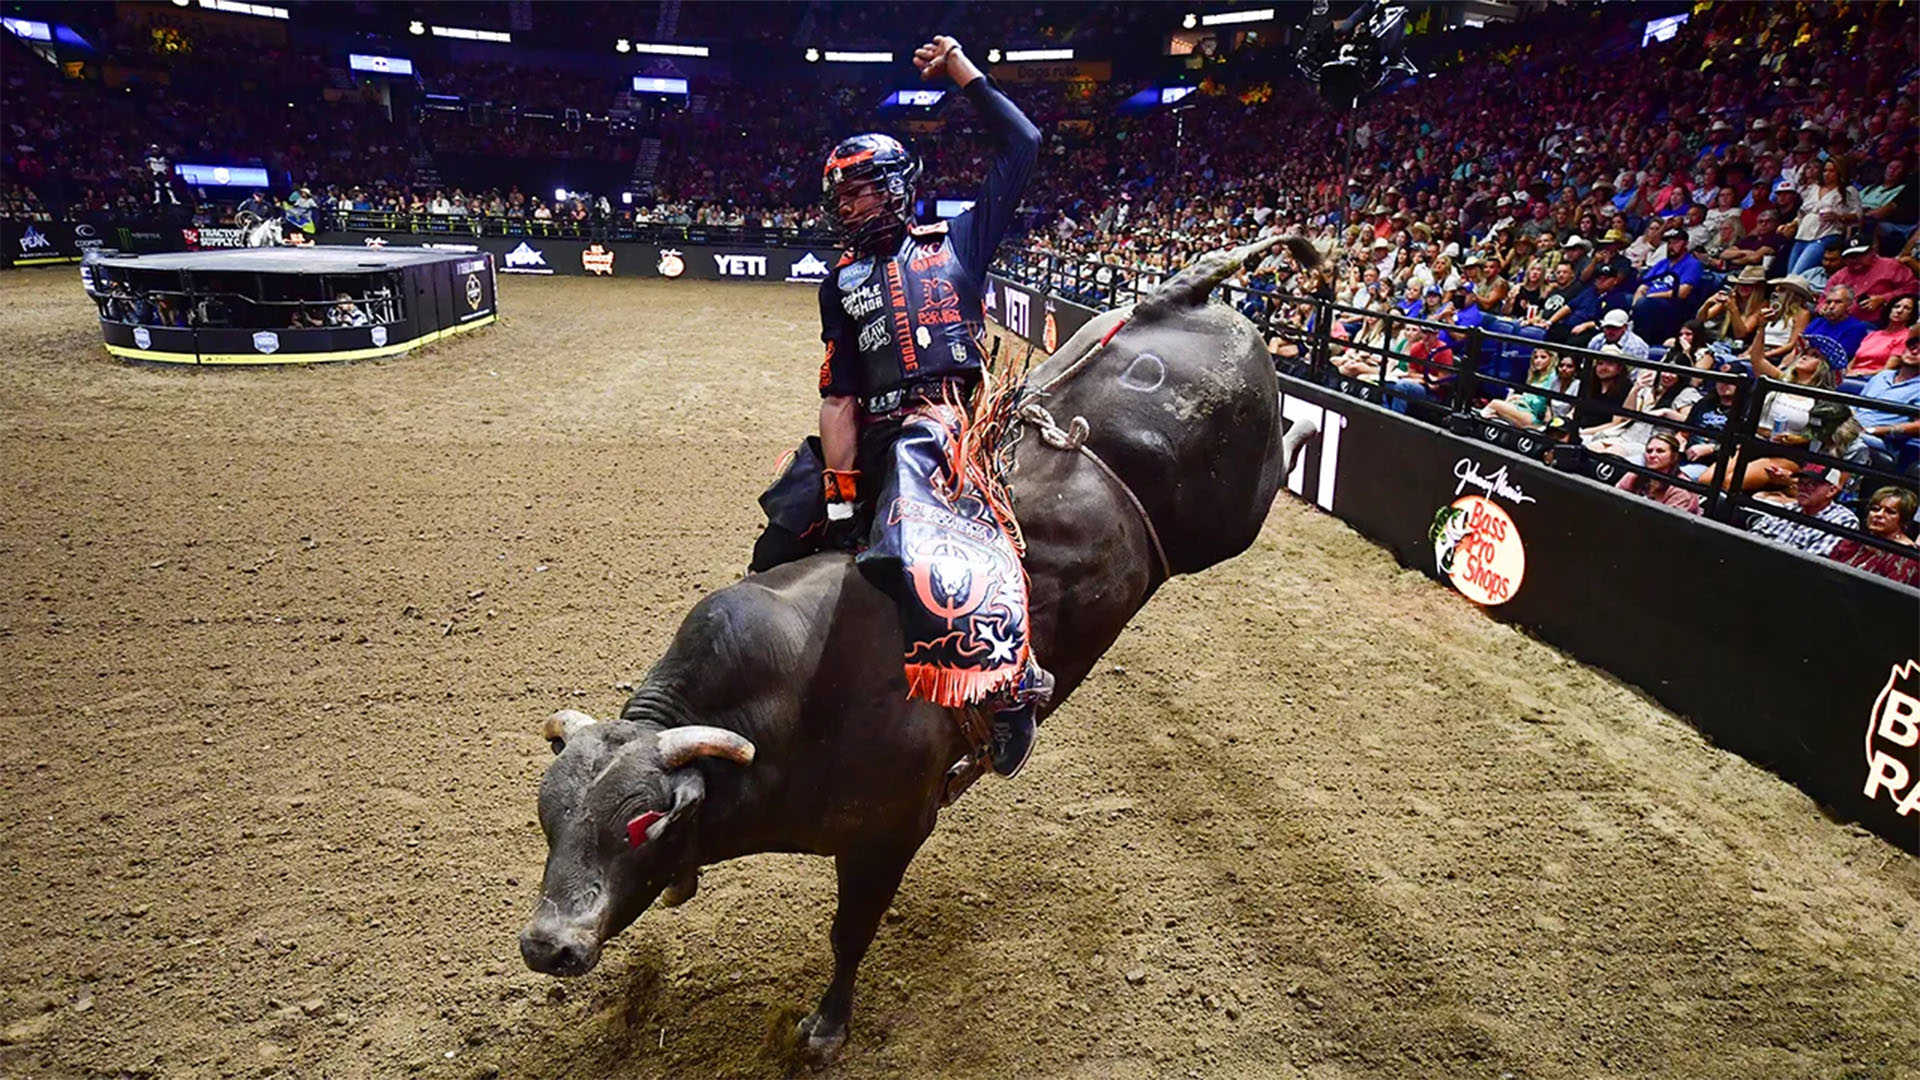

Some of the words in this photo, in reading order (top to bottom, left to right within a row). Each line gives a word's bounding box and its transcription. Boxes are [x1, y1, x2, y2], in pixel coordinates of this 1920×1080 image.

[75, 240, 104, 248] COOPER
[198, 228, 241, 238] TRACTO
[714, 254, 767, 276] YETI
[886, 261, 906, 308] OUTLAW
[1004, 286, 1031, 339] YETI
[893, 311, 919, 371] ATTITUDE
[1469, 501, 1508, 542] Bass
[1469, 529, 1495, 565] Pro
[1462, 554, 1510, 600] Shops
